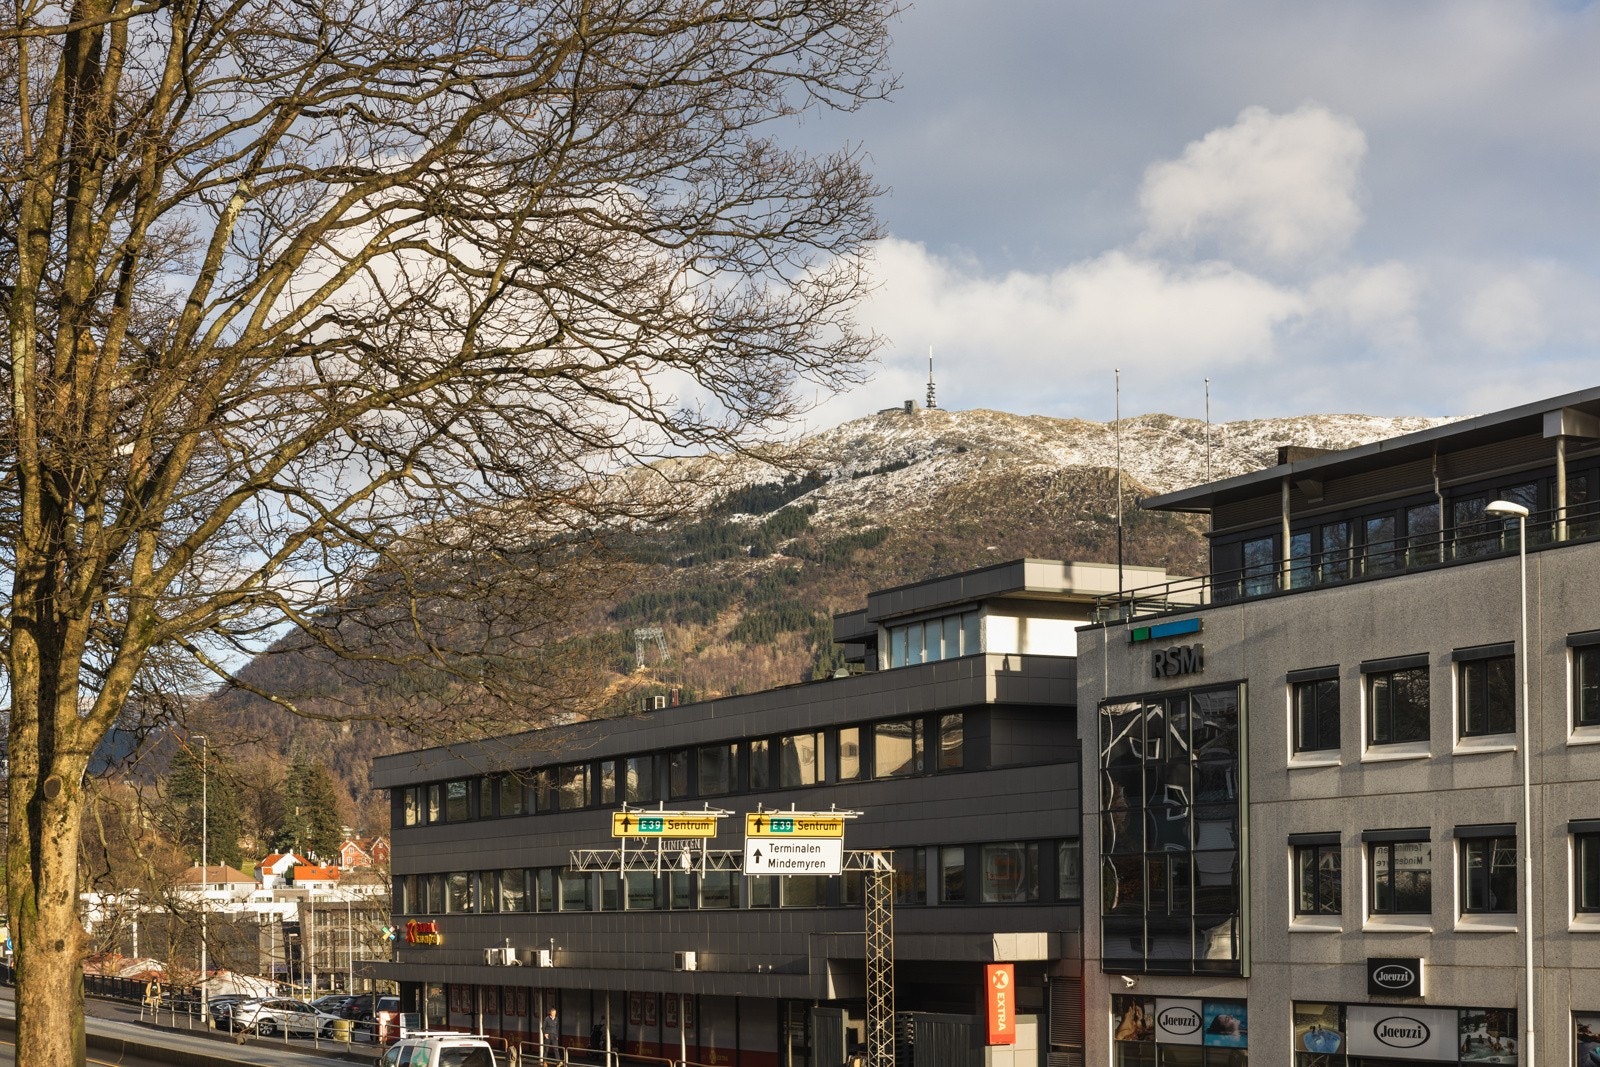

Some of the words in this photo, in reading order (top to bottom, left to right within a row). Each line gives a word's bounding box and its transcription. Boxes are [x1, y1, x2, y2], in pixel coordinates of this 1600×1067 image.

[1151, 643, 1204, 678] RSM
[668, 819, 710, 830] Sentrum
[797, 820, 838, 831] Sentrum
[769, 843, 821, 853] Terminalen
[767, 858, 826, 870] Mindemyren
[1378, 971, 1409, 982] Jacuzzi
[997, 992, 1007, 1032] EXTRA
[1162, 1014, 1196, 1027] Jacuzzi
[1380, 1025, 1422, 1039] Jacuzzi
